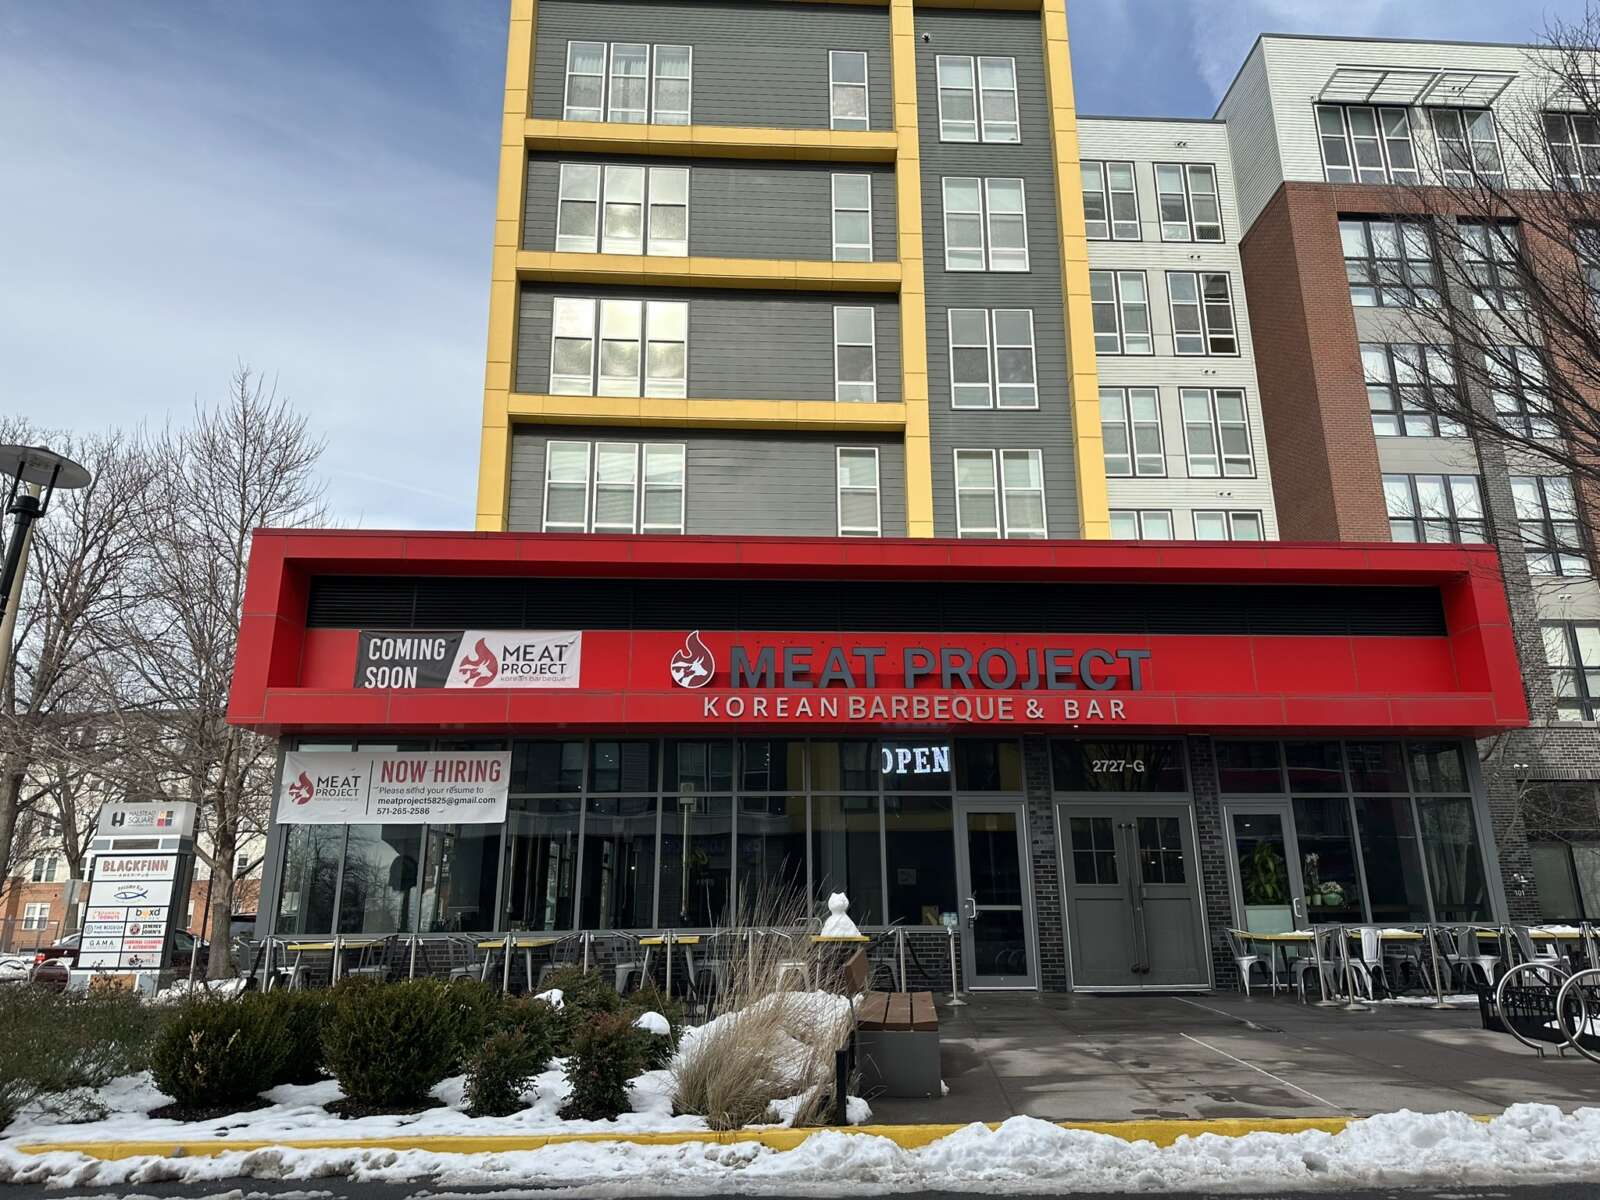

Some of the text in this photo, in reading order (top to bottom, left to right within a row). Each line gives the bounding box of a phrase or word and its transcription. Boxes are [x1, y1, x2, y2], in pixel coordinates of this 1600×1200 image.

[368, 638, 446, 660] COMING
[502, 644, 569, 662] MEAT
[501, 663, 567, 675] PROJECT
[730, 645, 1152, 691] MEAT PROJECT
[364, 666, 418, 689] SOON
[703, 695, 1127, 722] KOREAN BARBEQUE & BAR
[381, 760, 501, 783] NOW HIRING
[1092, 760, 1146, 773] 2727-G
[317, 776, 361, 788] MEAT
[315, 788, 360, 797] PROJECT
[379, 786, 404, 794] Please
[427, 788, 444, 796] your
[377, 796, 496, 806] meatproject5825@gmail.com
[128, 816, 154, 824] SQUARE
[102, 859, 169, 872] BLACKFINN
